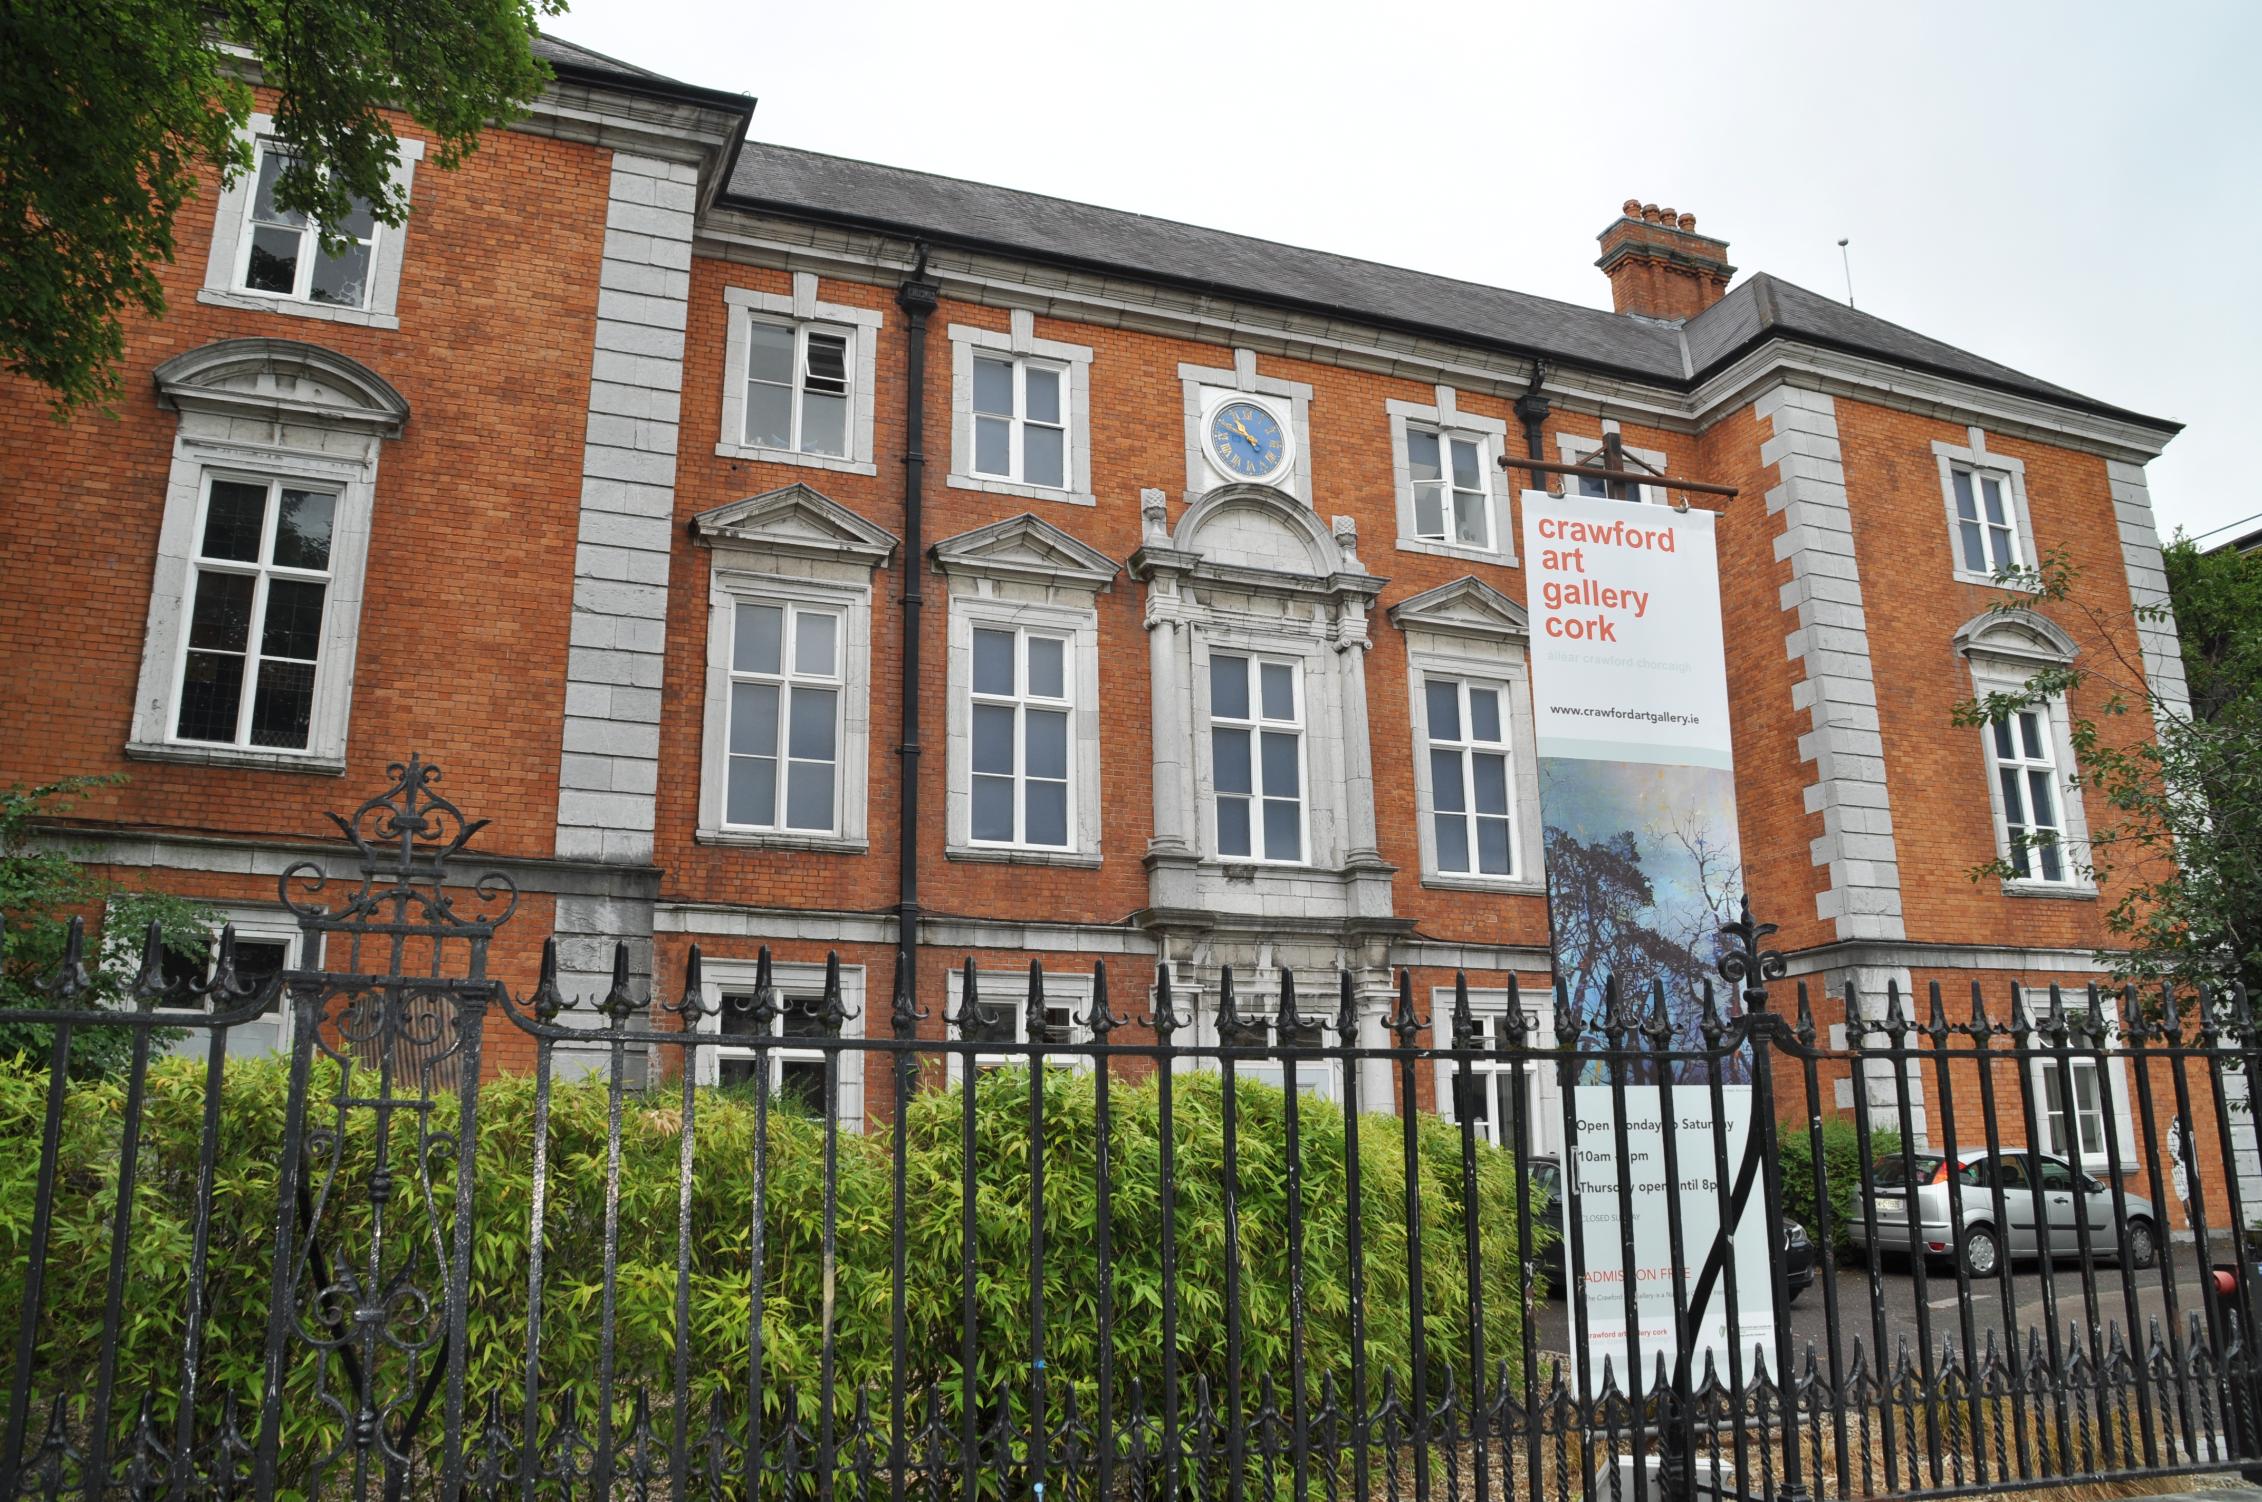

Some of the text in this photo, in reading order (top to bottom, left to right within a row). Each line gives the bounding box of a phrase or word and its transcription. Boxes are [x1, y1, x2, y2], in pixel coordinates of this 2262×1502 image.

[1538, 517, 1675, 553] crawford
[1542, 547, 1585, 573] art
[1543, 579, 1649, 618] gallery
[1545, 614, 1617, 643] cork
[1583, 654, 1633, 667] crawford
[1550, 705, 1699, 725] www.crawfordartgallery.ie
[1576, 1119, 1610, 1134] Open
[1615, 1118, 1661, 1134] onday
[1682, 1118, 1734, 1132] Satury
[1578, 1150, 1649, 1165] 10am pm
[1674, 1178, 1699, 1191] ntil
[1702, 1178, 1722, 1193] 8p
[1584, 1268, 1656, 1283] ADMISON
[1588, 1330, 1616, 1339] rawford
